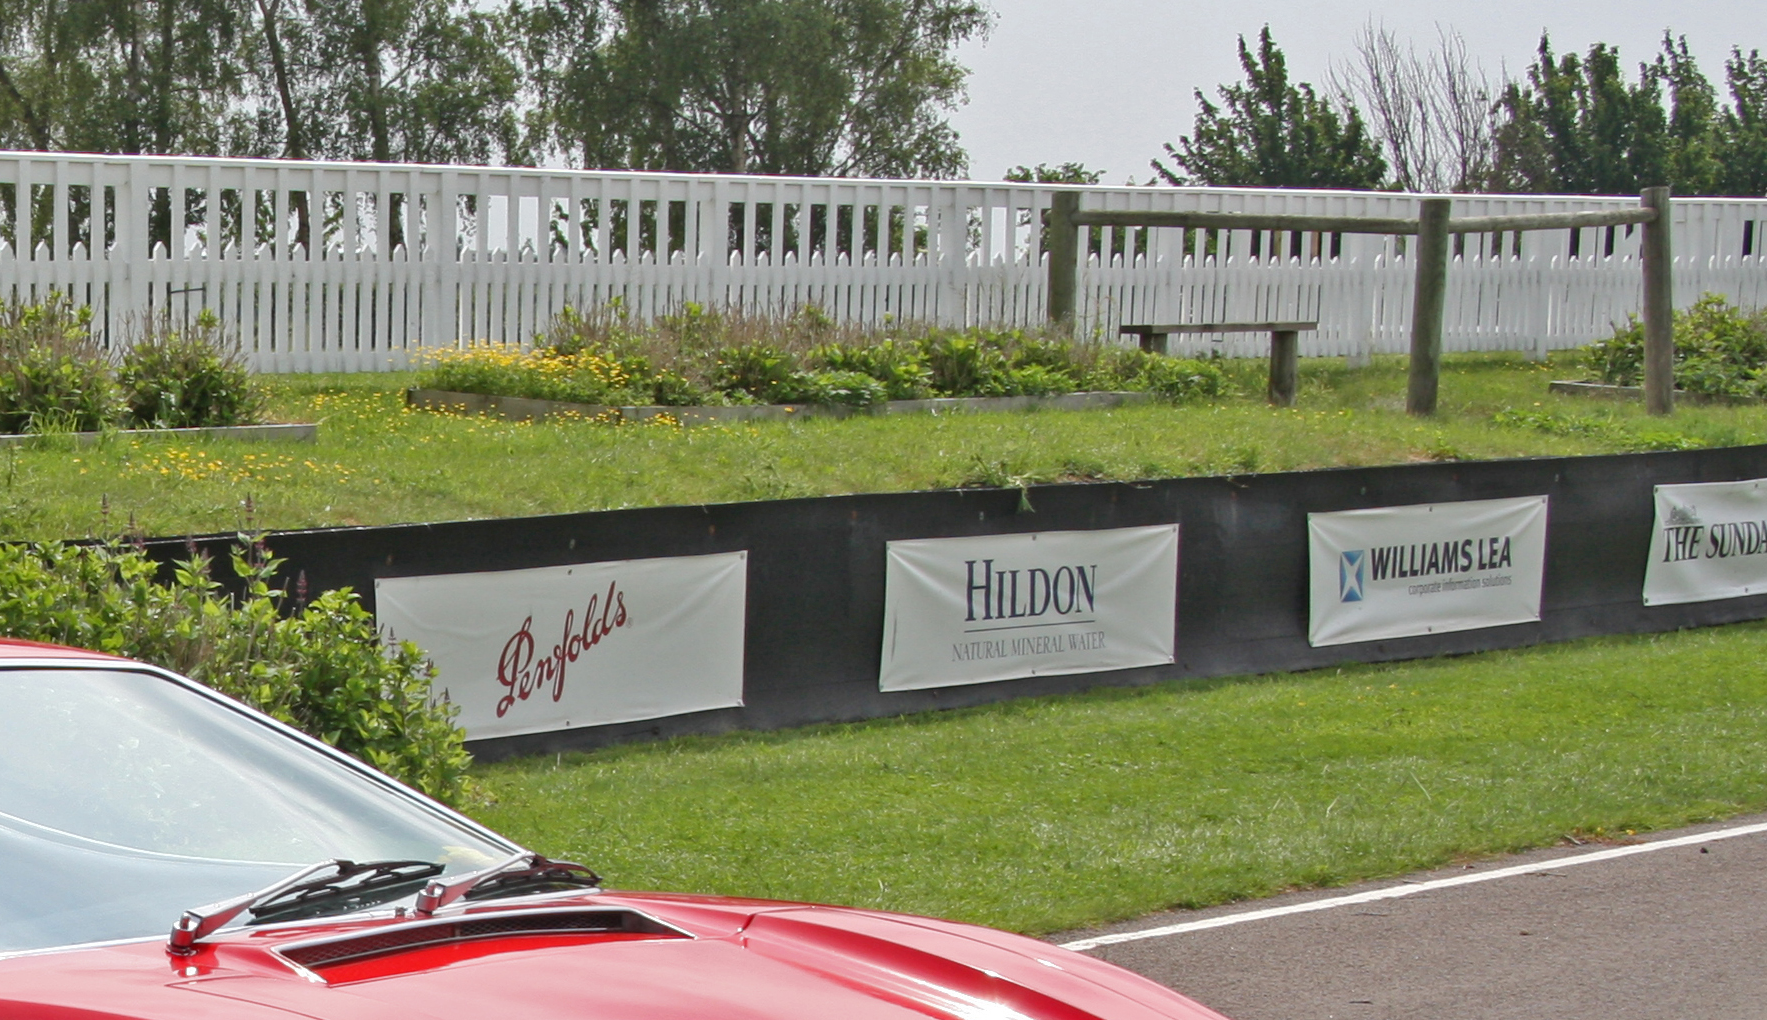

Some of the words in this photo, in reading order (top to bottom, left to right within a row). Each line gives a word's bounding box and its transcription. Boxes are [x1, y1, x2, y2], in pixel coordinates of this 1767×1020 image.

[1370, 538, 1473, 580] WILLIAMS
[1478, 536, 1512, 571] LEA
[1662, 525, 1704, 563] THE
[964, 559, 1097, 622] HILDON
[1408, 581, 1441, 598] corporate
[1441, 577, 1481, 592] information
[1482, 573, 1512, 588] solutions
[496, 580, 627, 718] Penfolds
[951, 638, 1008, 662] NATURAL
[1010, 634, 1064, 657] MINERAL
[1068, 631, 1106, 652] WATER
